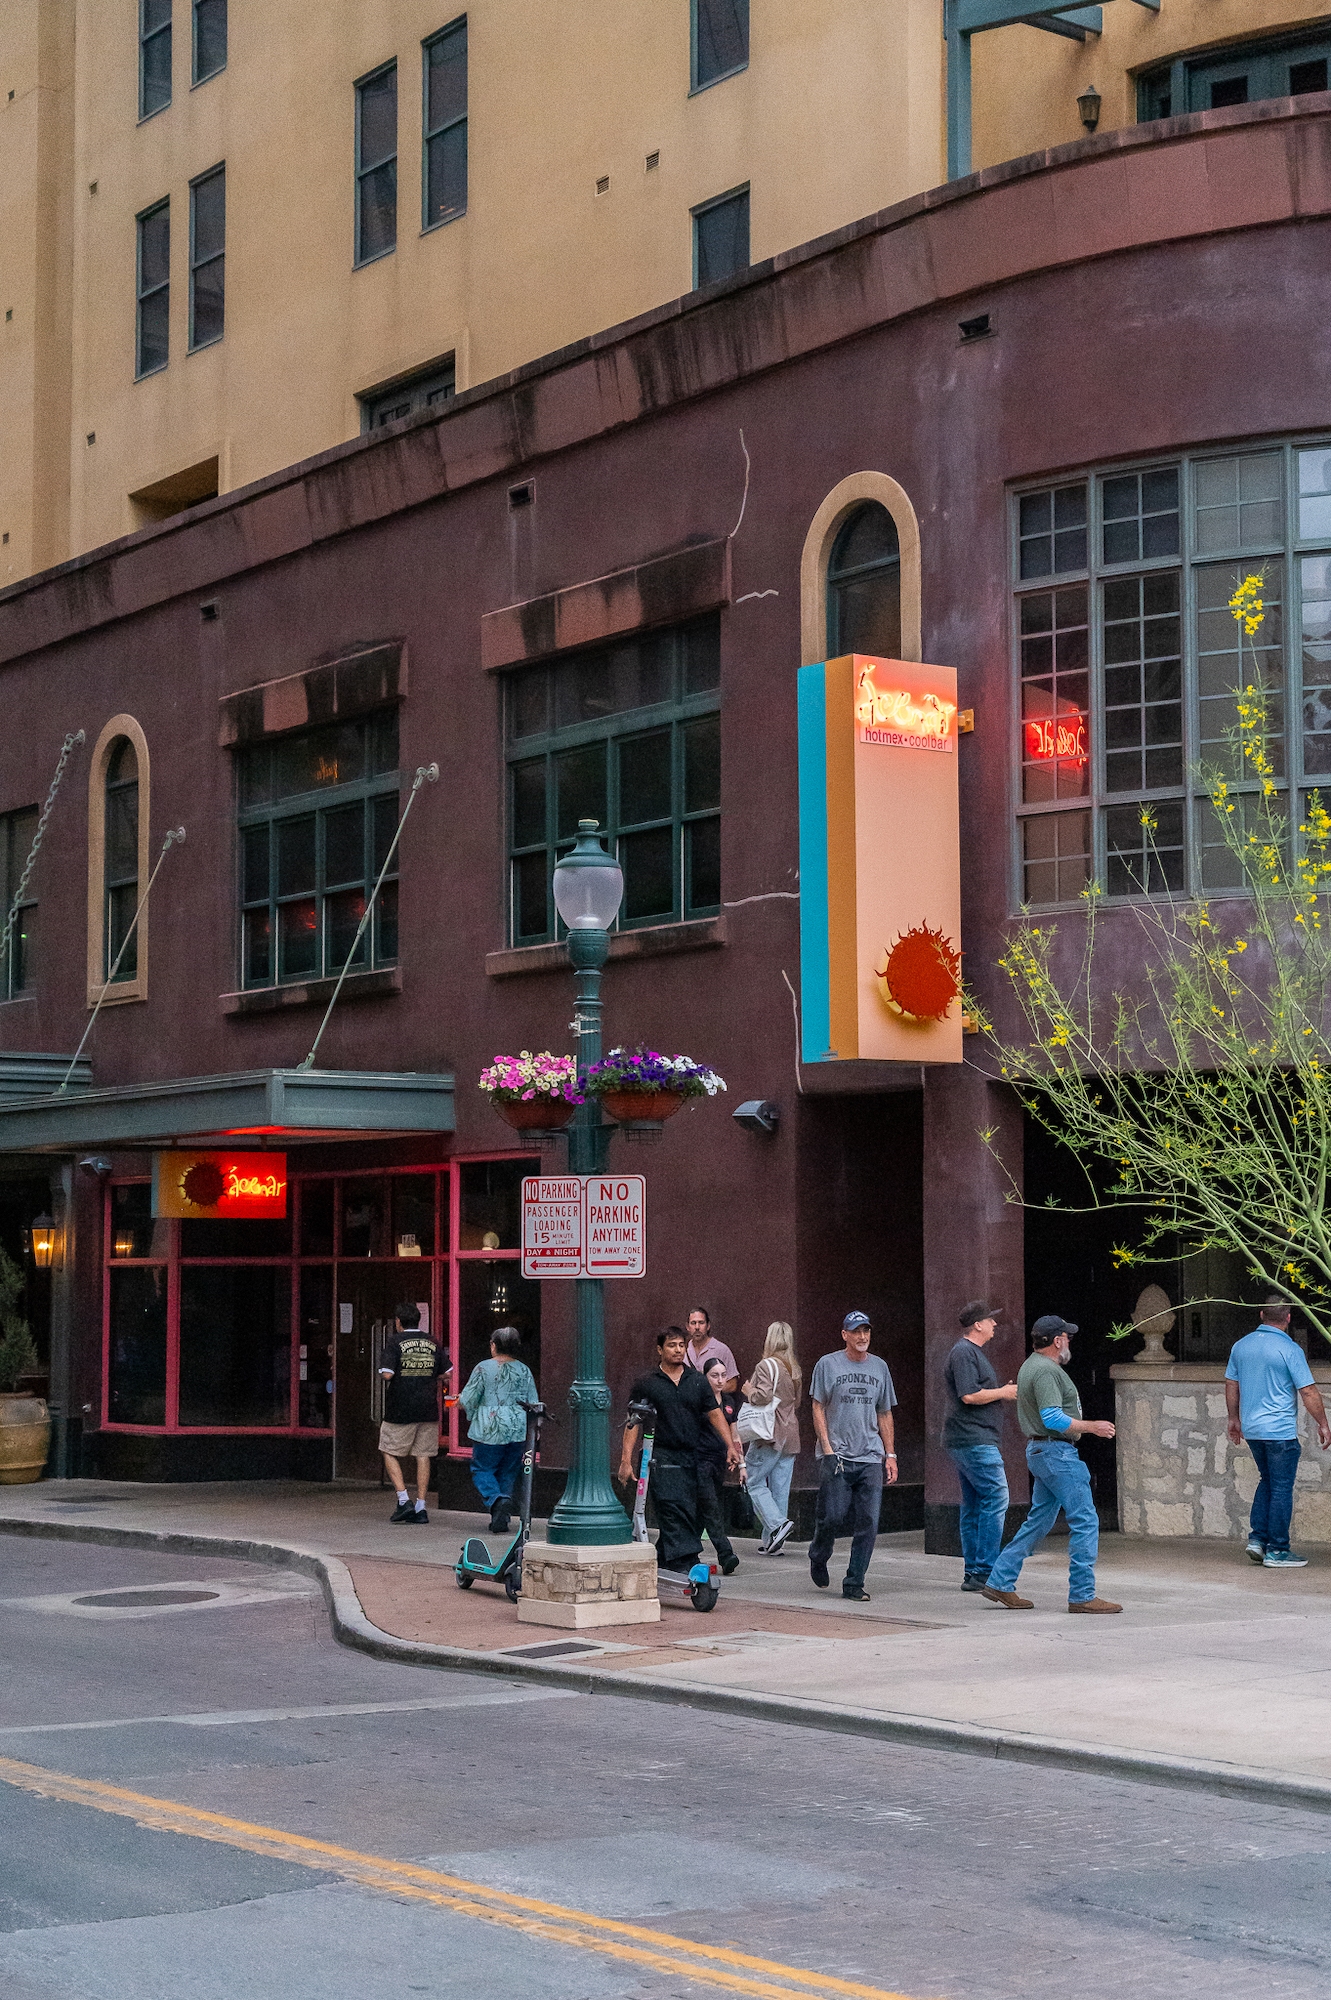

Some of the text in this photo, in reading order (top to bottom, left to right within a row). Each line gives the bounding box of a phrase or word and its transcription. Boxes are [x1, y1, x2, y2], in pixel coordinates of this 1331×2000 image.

[526, 1182, 577, 1201] NO PARKING
[600, 1183, 629, 1201] NO
[527, 1205, 578, 1217] PASSENGER
[590, 1205, 639, 1224] PARKING
[534, 1220, 571, 1231] LOADING
[534, 1232, 550, 1244] 15
[592, 1227, 637, 1242] ANYTIME
[554, 1248, 579, 1256] NIGHT
[604, 1246, 620, 1254] AWAY
[623, 1246, 641, 1254] ZONE
[840, 1395, 873, 1405] NEW YORK
[523, 1449, 533, 1475] veo
